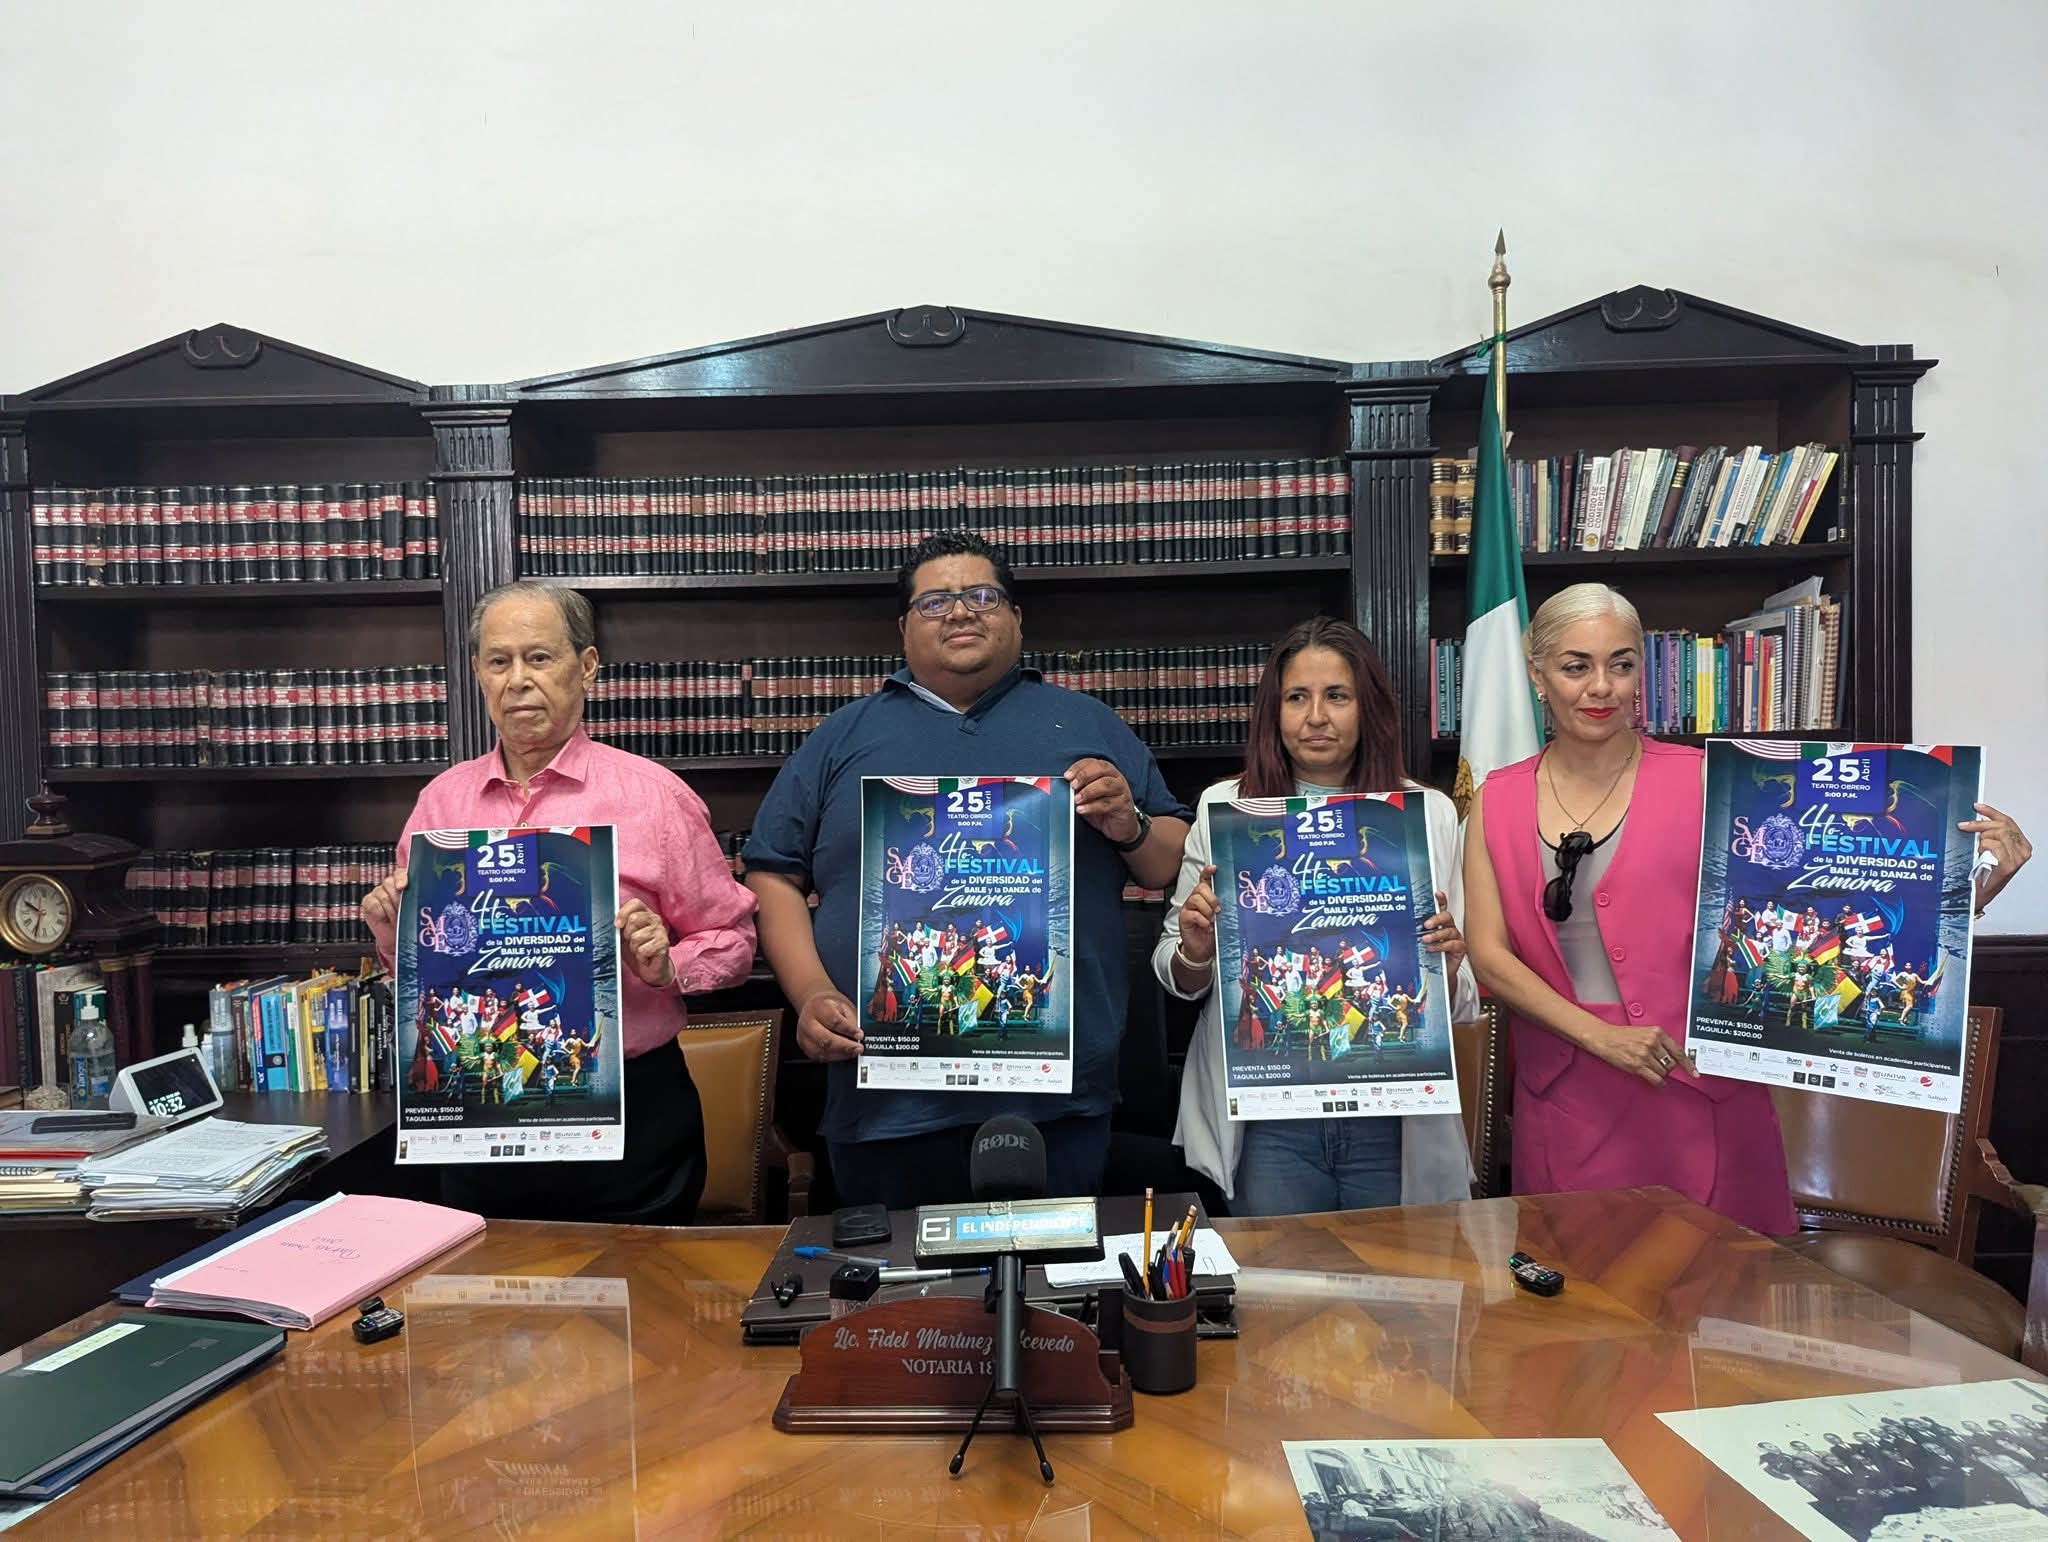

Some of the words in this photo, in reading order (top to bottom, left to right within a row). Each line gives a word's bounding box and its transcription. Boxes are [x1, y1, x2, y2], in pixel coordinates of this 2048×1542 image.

[1591, 486, 1599, 496] DE
[1587, 498, 1598, 528] CÓDIGO
[1595, 486, 1606, 528] COMERCIO
[1811, 758, 1860, 782] 25
[1862, 758, 1871, 782] Abril
[1841, 783, 1871, 791] OBRERO
[947, 791, 984, 813] 25
[984, 790, 992, 811] Abril
[1296, 810, 1335, 833] 25
[1336, 809, 1344, 830] Abril
[477, 844, 516, 868] 25
[517, 843, 525, 865] Abril
[1805, 833, 1938, 859] FESTIVAL
[944, 858, 1045, 875] FESTIVAL
[1813, 856, 1823, 864] de
[1825, 856, 1833, 864] la
[1836, 855, 1917, 870] DIVERSIDAD
[1920, 862, 1935, 871] del
[1829, 866, 1859, 876] BAILE
[1861, 870, 1867, 878] y
[1869, 869, 1878, 877] la
[1880, 870, 1917, 881] DANZA
[1919, 872, 1933, 881] de
[969, 876, 1030, 885] DIVERSIDAD
[1299, 875, 1407, 896] FESTIVAL
[1786, 864, 1896, 893] Zamora
[931, 884, 1015, 911] Zamora
[988, 887, 994, 895] y
[1003, 886, 1030, 894] DANZA
[1327, 894, 1393, 904] DIVERSIDAD
[1290, 905, 1379, 934] Zamora
[1323, 906, 1348, 914] BAILE
[1349, 907, 1355, 915] y
[1364, 904, 1394, 912] DANZA
[478, 915, 588, 936] FESTIVAL
[496, 938, 503, 946] la
[505, 935, 571, 946] DIVERSIDAD
[573, 936, 586, 944] del
[500, 947, 525, 956] BAILE
[533, 947, 540, 955] la
[542, 946, 572, 954] DANZA
[574, 945, 585, 953] de
[467, 945, 556, 976] Zamora
[1696, 1016, 1735, 1027] PREVENTA:
[1736, 1021, 1764, 1031] $150.00
[1696, 1024, 1732, 1035] TAQUILLA:
[1733, 1029, 1763, 1040] $200.00
[1854, 1051, 1874, 1060] boletos
[1884, 1056, 1913, 1065] academias
[150, 1096, 186, 1117] 10:32
[978, 1133, 1030, 1154] RØDE
[962, 1221, 977, 1233] EL
[832, 1327, 860, 1350] Lic.
[868, 1327, 909, 1350] Fidel
[902, 1359, 974, 1375] NOTARIA
